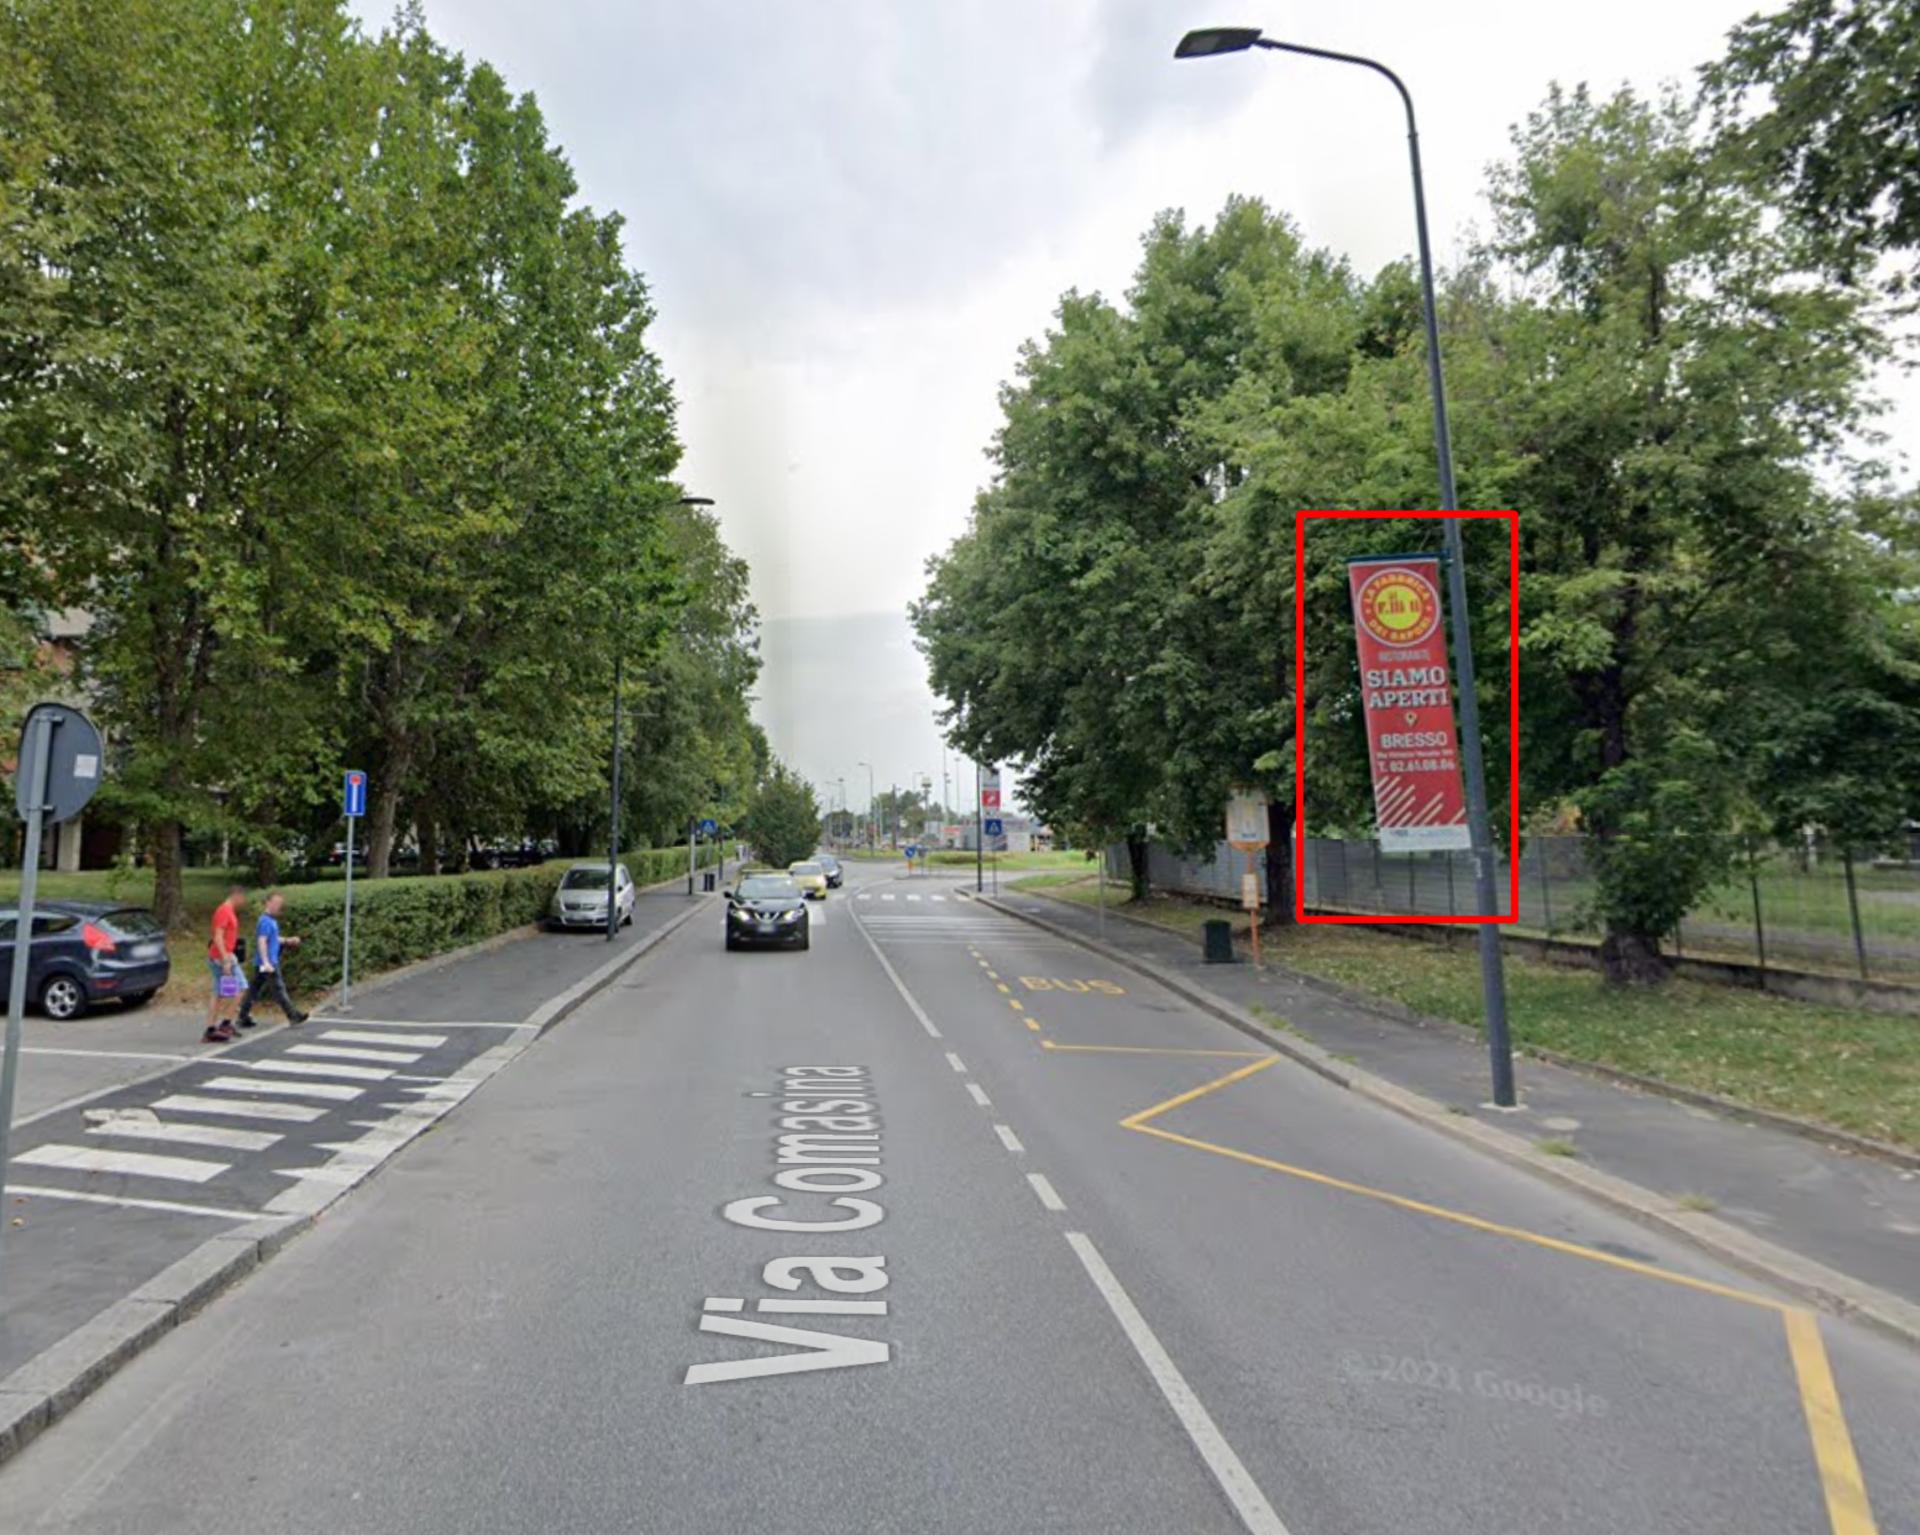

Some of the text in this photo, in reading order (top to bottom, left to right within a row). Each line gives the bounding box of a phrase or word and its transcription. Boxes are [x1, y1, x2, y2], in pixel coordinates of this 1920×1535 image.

[1366, 666, 1445, 688] SIAMO
[1369, 688, 1448, 708] APERTI
[1381, 731, 1447, 748] BRESSO
[1018, 976, 1127, 995] BUS
